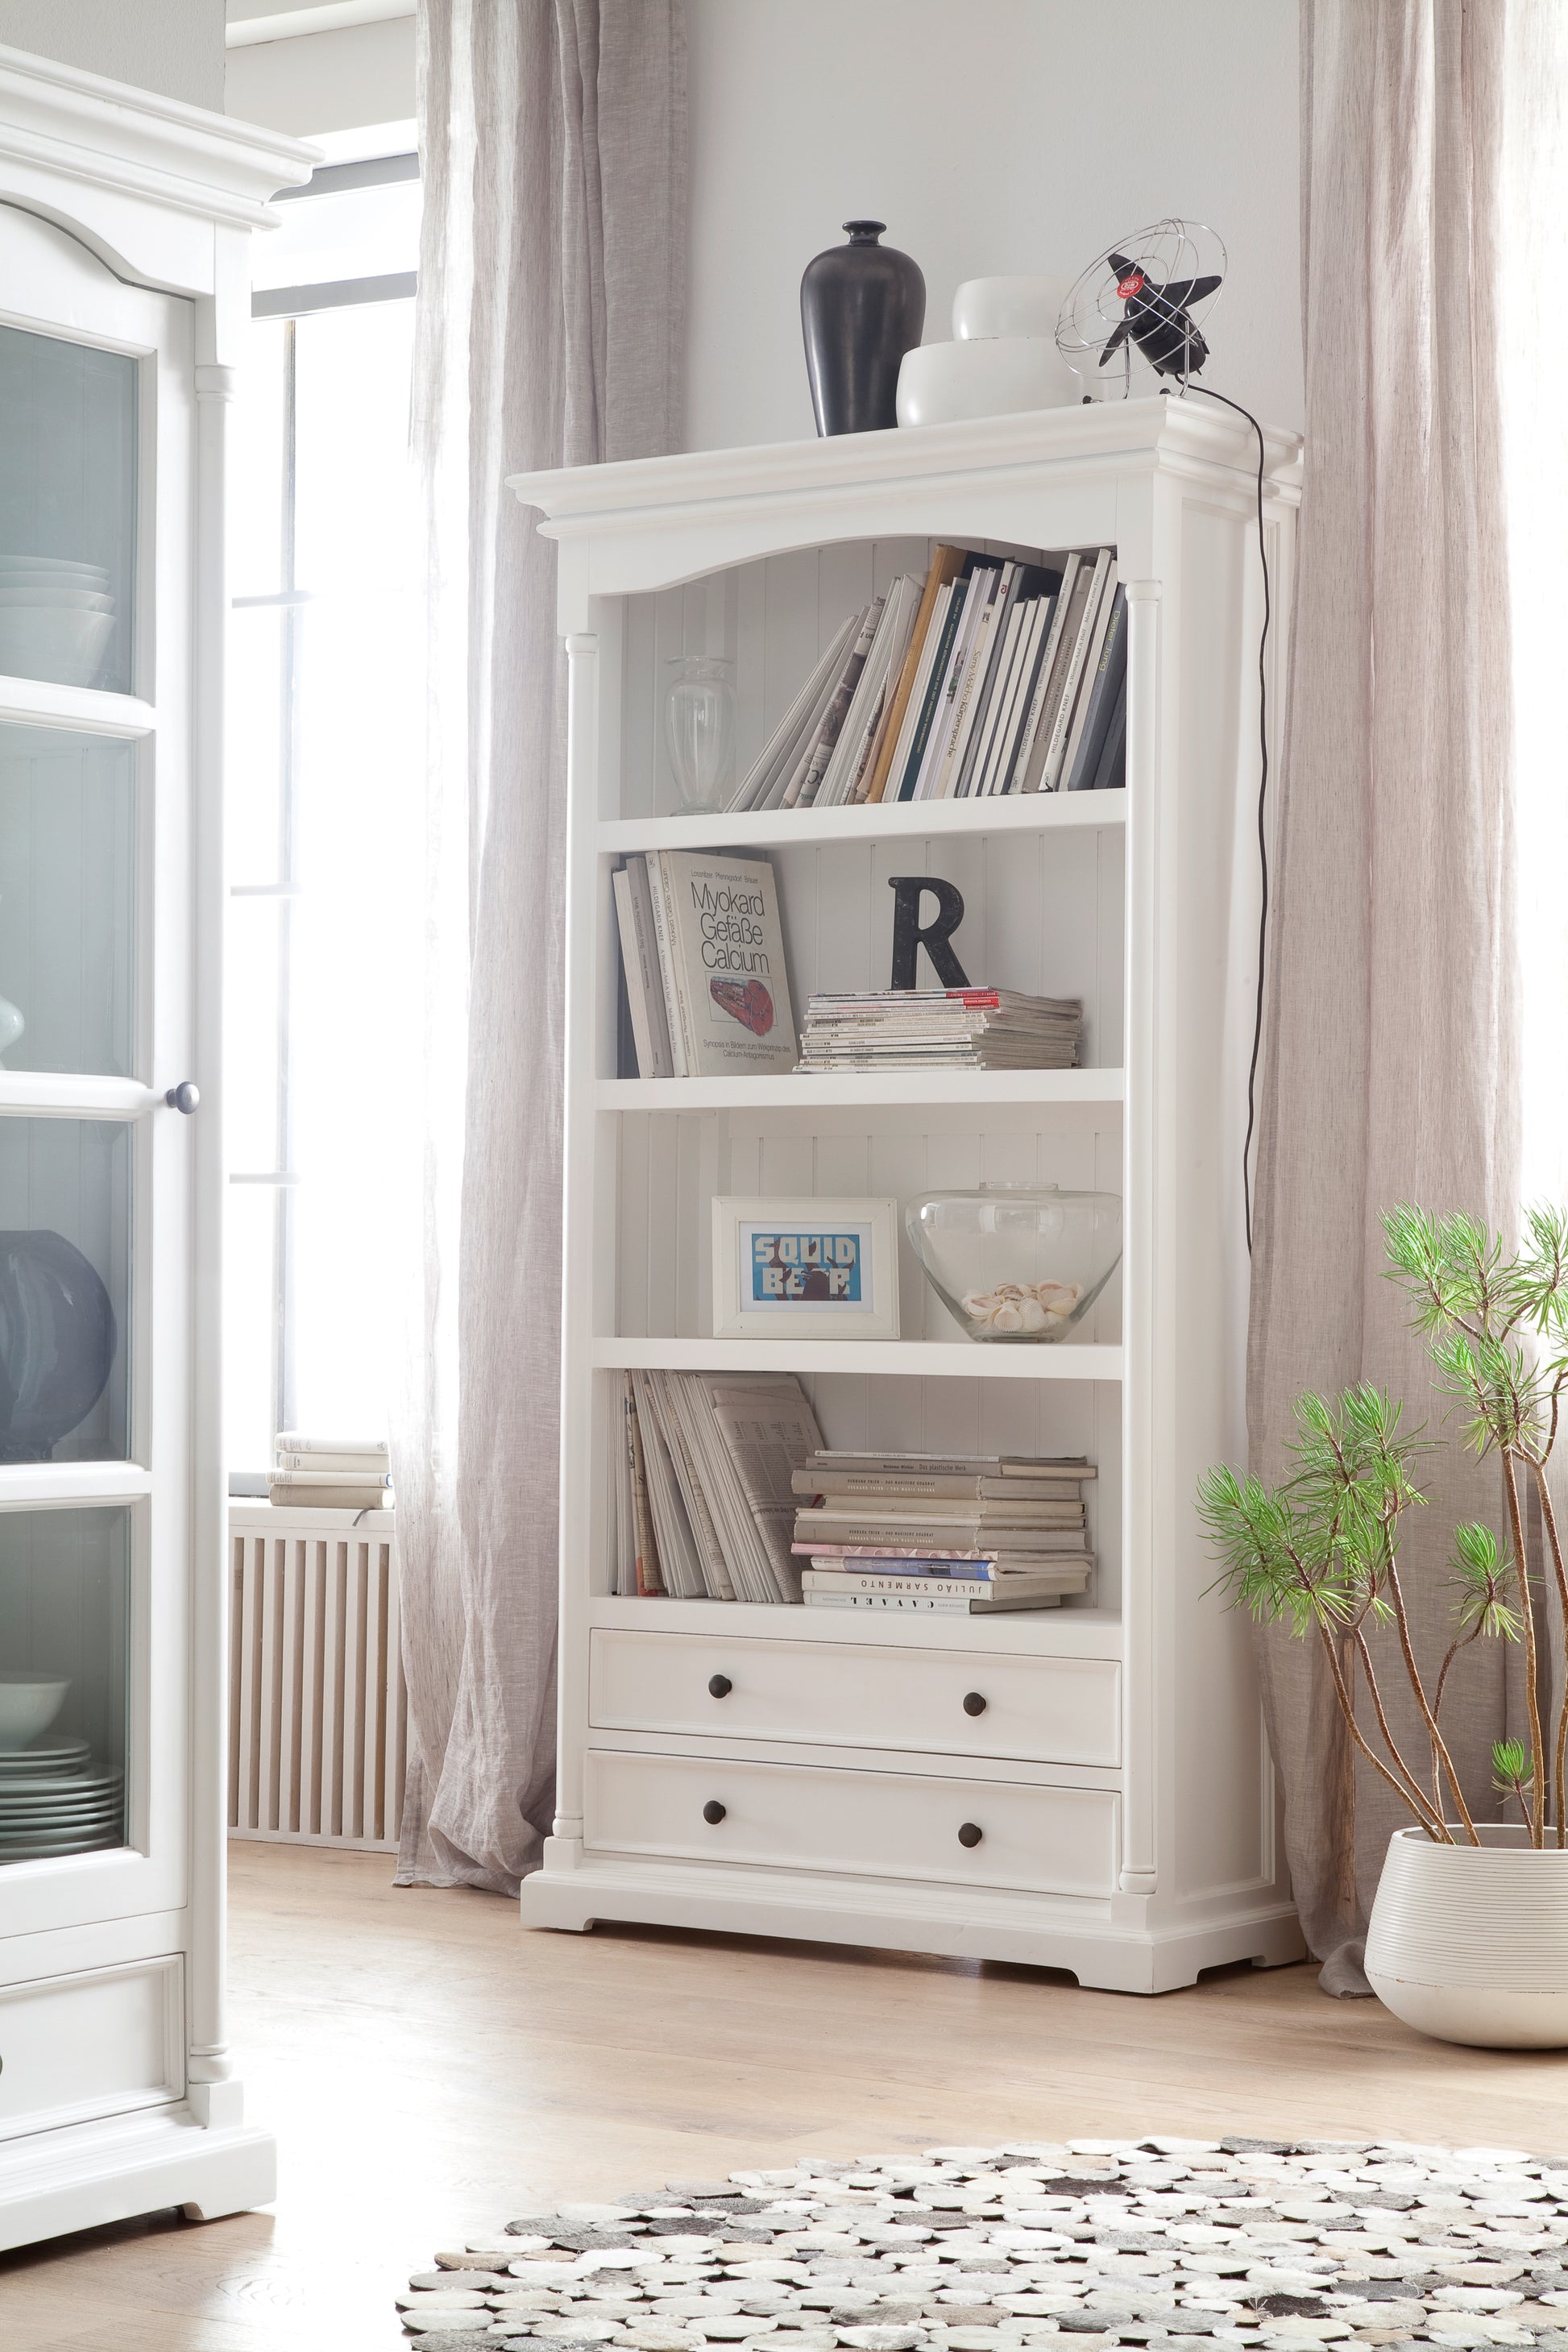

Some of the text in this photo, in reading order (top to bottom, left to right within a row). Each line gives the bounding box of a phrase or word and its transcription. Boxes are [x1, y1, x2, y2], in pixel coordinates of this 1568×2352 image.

[1099, 610, 1120, 671] Dieter Jung
[947, 650, 981, 757] Samy Molcho Körpersprache
[1051, 714, 1065, 753] HILDEGARD
[1070, 660, 1078, 681] Woman
[1019, 718, 1035, 758] HILDEGARD
[1031, 698, 1039, 716] KNEF
[653, 886, 662, 923] HILDEGARD
[691, 881, 765, 917] Myokard
[669, 919, 677, 946] Myokard
[700, 915, 763, 945] Gefäße
[888, 877, 972, 990] R
[702, 940, 769, 973] Calcium
[703, 1039, 725, 1049] Synopsis
[730, 1040, 747, 1048] Bildern
[723, 1049, 775, 1060] Calcium-Antagonismus
[755, 1237, 856, 1265] SQUID
[762, 1267, 850, 1294] BER
[861, 1579, 982, 1594] JULIÃO SARMENTO
[850, 1597, 934, 1609] CAVAEL
